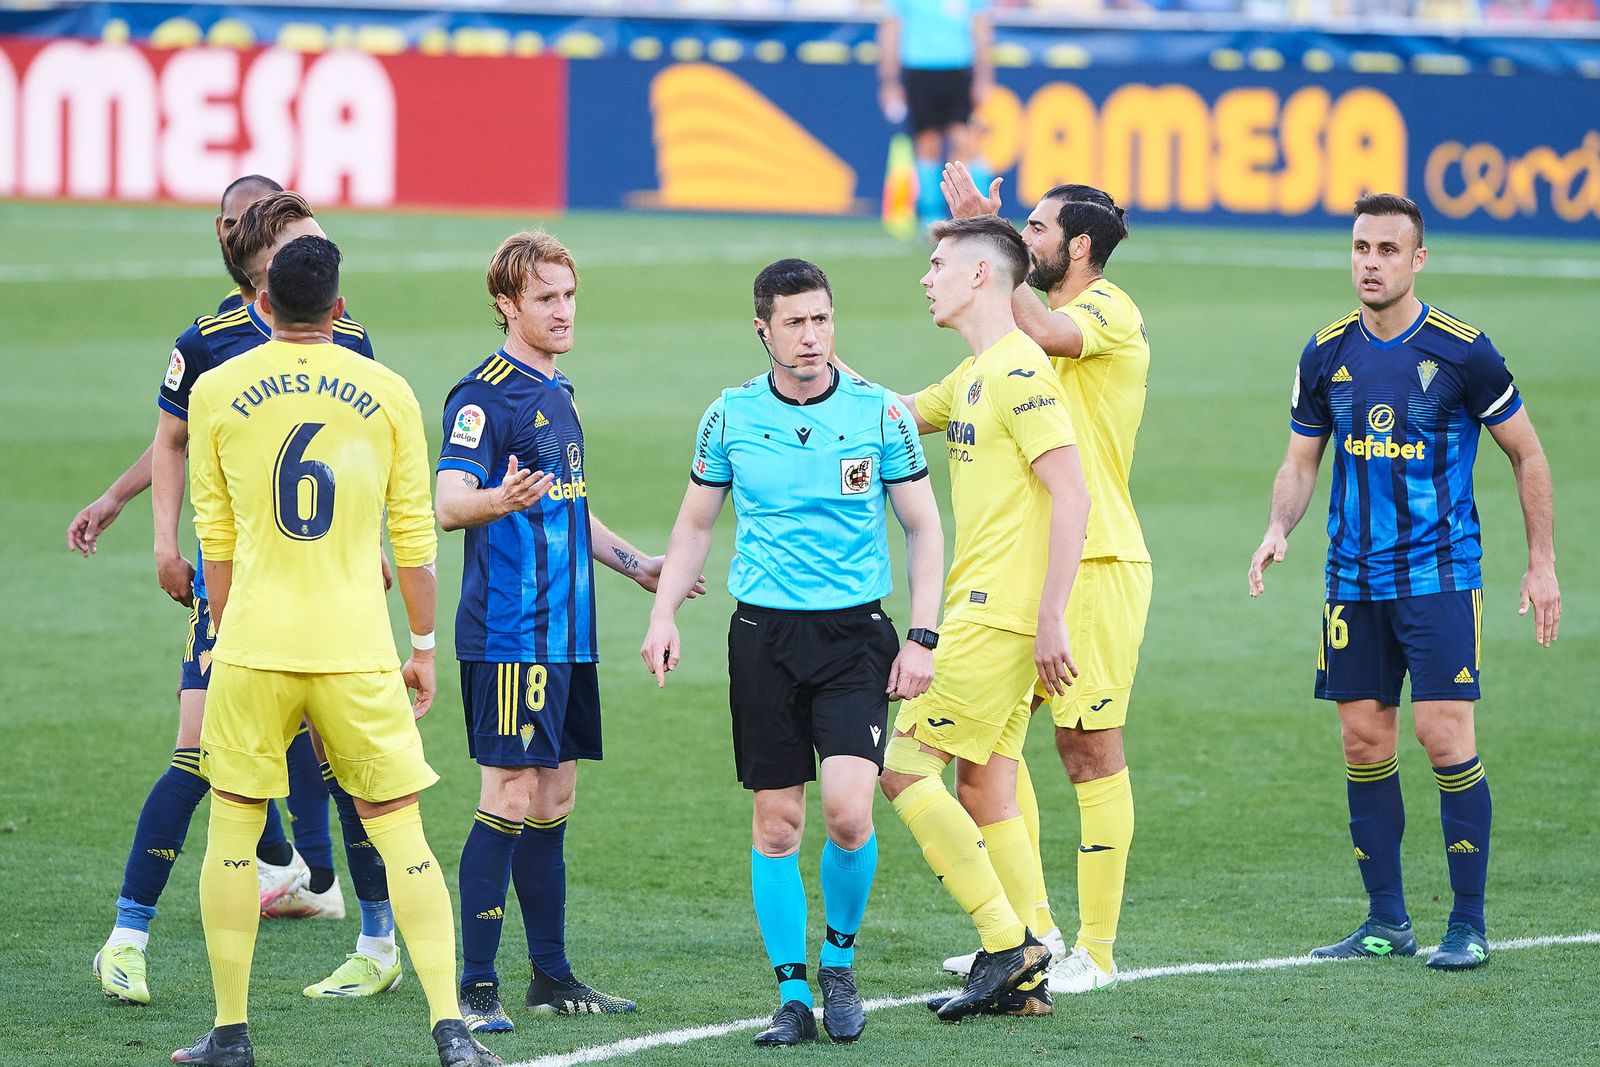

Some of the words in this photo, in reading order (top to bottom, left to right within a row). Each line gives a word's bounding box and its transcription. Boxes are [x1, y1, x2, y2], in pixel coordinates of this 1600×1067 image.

[0, 40, 396, 207] MESA
[231, 373, 311, 419] FUNES
[316, 375, 382, 420] MORI
[452, 431, 477, 443] LaLiga
[698, 411, 720, 459] WÜRTH
[897, 420, 918, 471] WÜRTH
[1344, 433, 1426, 461] dafabet
[273, 423, 335, 541] 6
[1324, 602, 1349, 650] 16
[525, 664, 548, 712] 8
